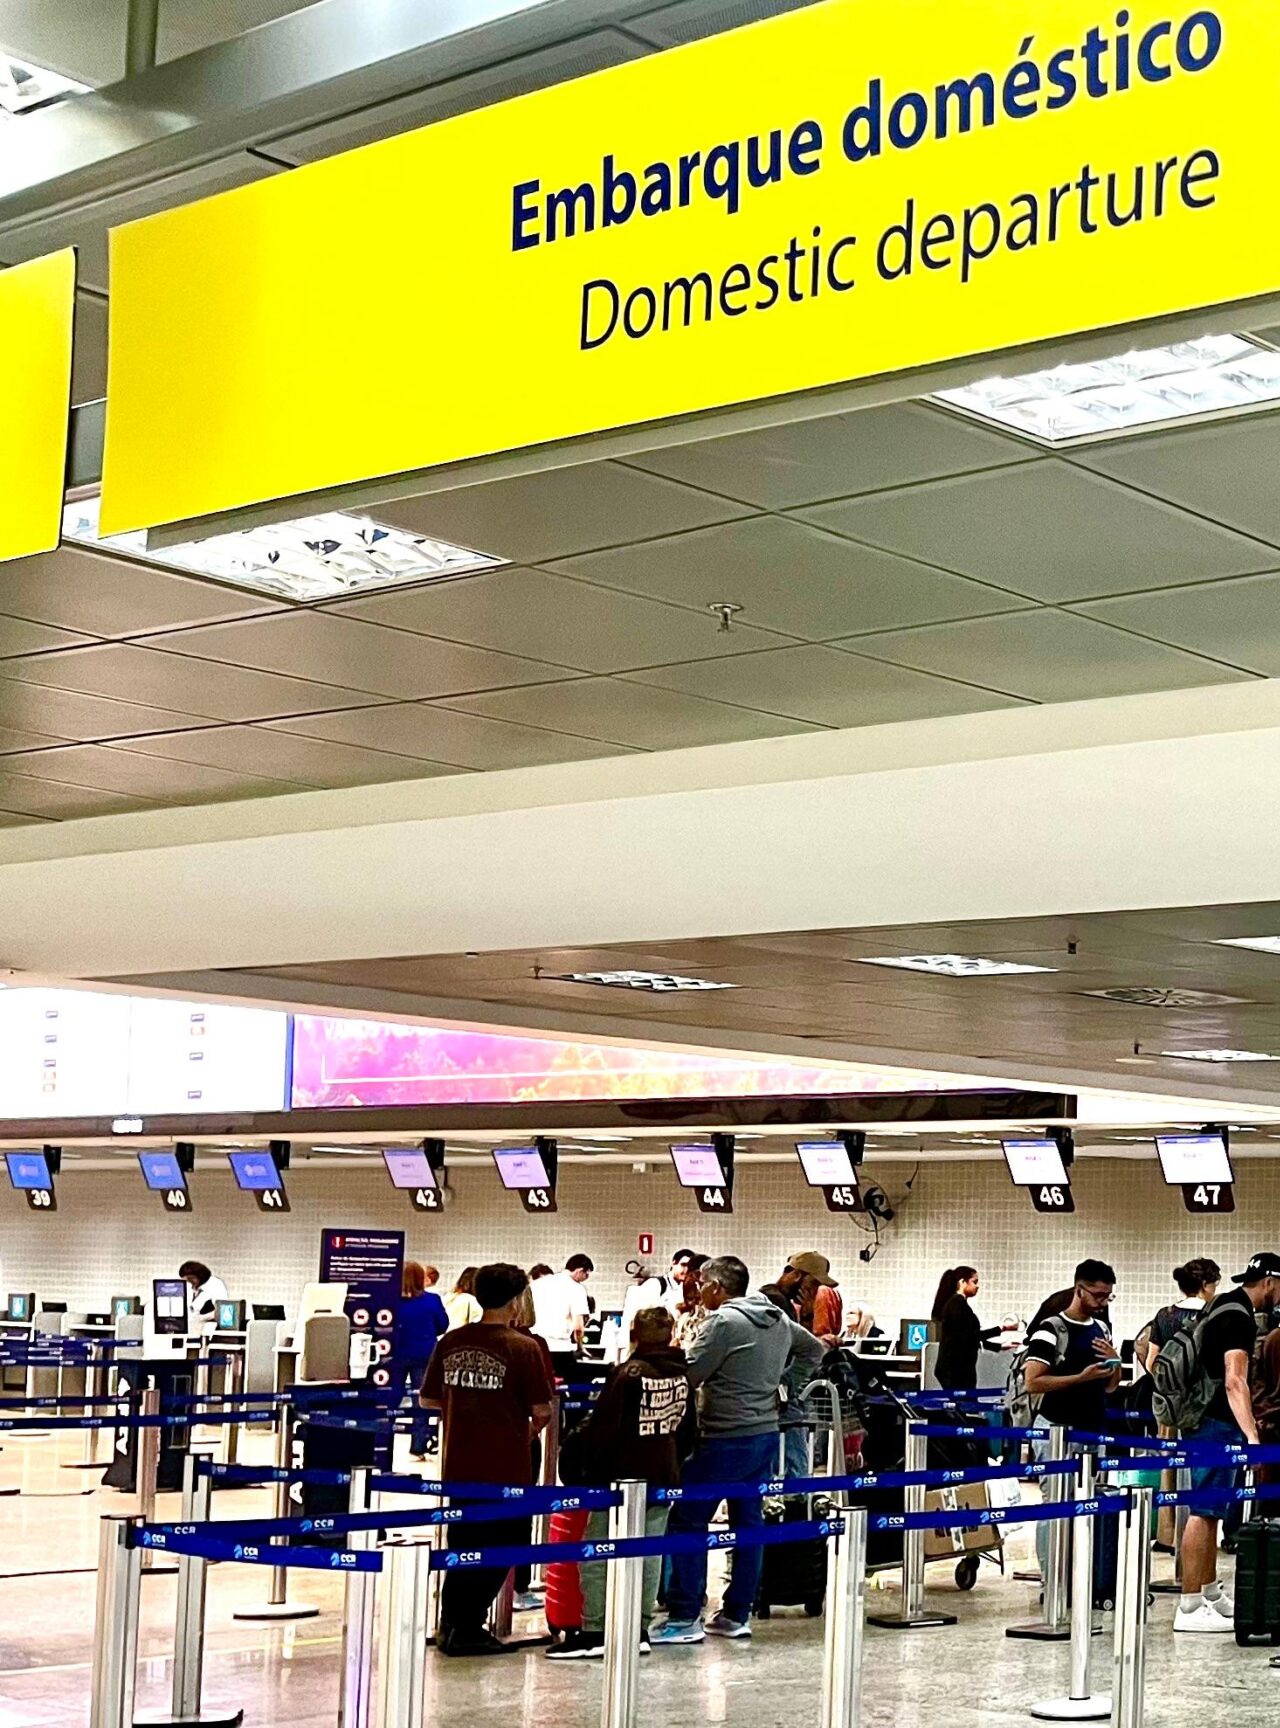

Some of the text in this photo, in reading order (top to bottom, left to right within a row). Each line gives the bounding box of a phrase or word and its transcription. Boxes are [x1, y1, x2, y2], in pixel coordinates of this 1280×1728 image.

[512, 9, 1222, 252] Embarque doméstico
[580, 148, 1220, 352] Domestic departure
[31, 1189, 50, 1207] 39
[167, 1190, 186, 1208] 40
[262, 1190, 282, 1208] 41
[416, 1189, 438, 1207] 42
[528, 1189, 550, 1207] 43
[703, 1188, 725, 1206] 44
[832, 1187, 855, 1206] 45
[1039, 1186, 1065, 1206] 46
[1193, 1185, 1221, 1205] 47
[769, 1482, 784, 1491] CCR
[667, 1489, 683, 1497] CCR
[1165, 1493, 1178, 1501] CCR
[563, 1498, 580, 1506] CCR
[1085, 1502, 1098, 1510] CCR
[444, 1510, 462, 1518] CCR
[991, 1511, 1005, 1519] CCR
[314, 1519, 334, 1527] CCR
[889, 1517, 904, 1525] CCR
[175, 1526, 196, 1534] CCR
[152, 1534, 166, 1544] CCR
[719, 1533, 736, 1542] CCR
[244, 1546, 259, 1556] CCR
[596, 1544, 615, 1552] CCR
[341, 1554, 357, 1563] CCR
[460, 1552, 481, 1562] CCR
